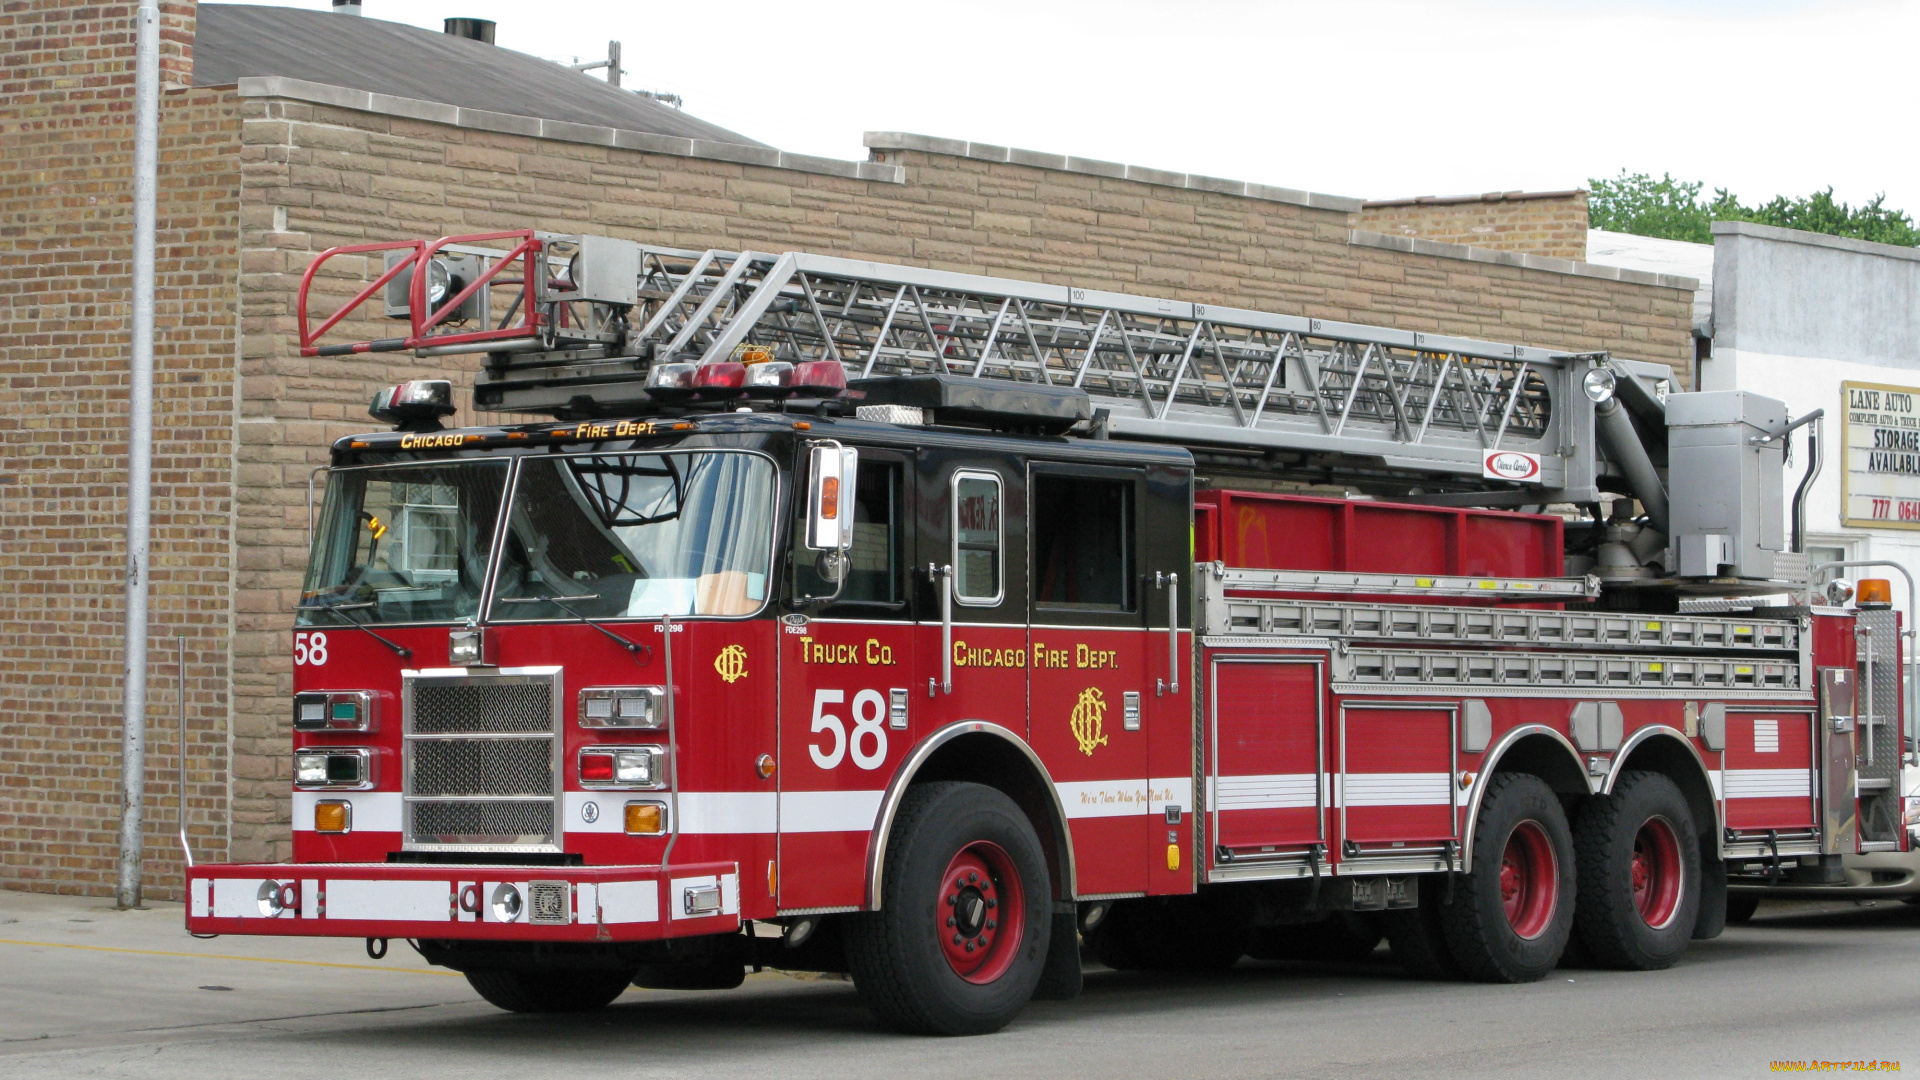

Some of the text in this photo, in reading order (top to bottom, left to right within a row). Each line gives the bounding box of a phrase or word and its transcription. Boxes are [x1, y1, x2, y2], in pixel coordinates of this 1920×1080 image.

[1073, 291, 1085, 301] 100
[1196, 306, 1205, 316] 90
[1313, 321, 1321, 330] 80
[1417, 335, 1425, 344] 70
[1517, 347, 1525, 356] 60
[1850, 389, 1912, 413] LANE AUTO
[1849, 412, 1878, 424] COMPLETE
[1879, 414, 1894, 425] AUTO
[1900, 416, 1917, 427] TRUCK
[401, 420, 657, 448] CHICAGO FIRE DEPT.
[1874, 428, 1919, 451] STORAGE
[1872, 498, 1891, 519] 777
[653, 624, 684, 633] FD298
[785, 625, 808, 635] FDE298
[294, 631, 328, 666] 58
[800, 636, 897, 665] TRUCK CO.
[953, 640, 1119, 669] CHICAGO FIRE DEPT.
[808, 688, 888, 770] 58
[1099, 790, 1115, 804] There
[1117, 789, 1133, 803] When
